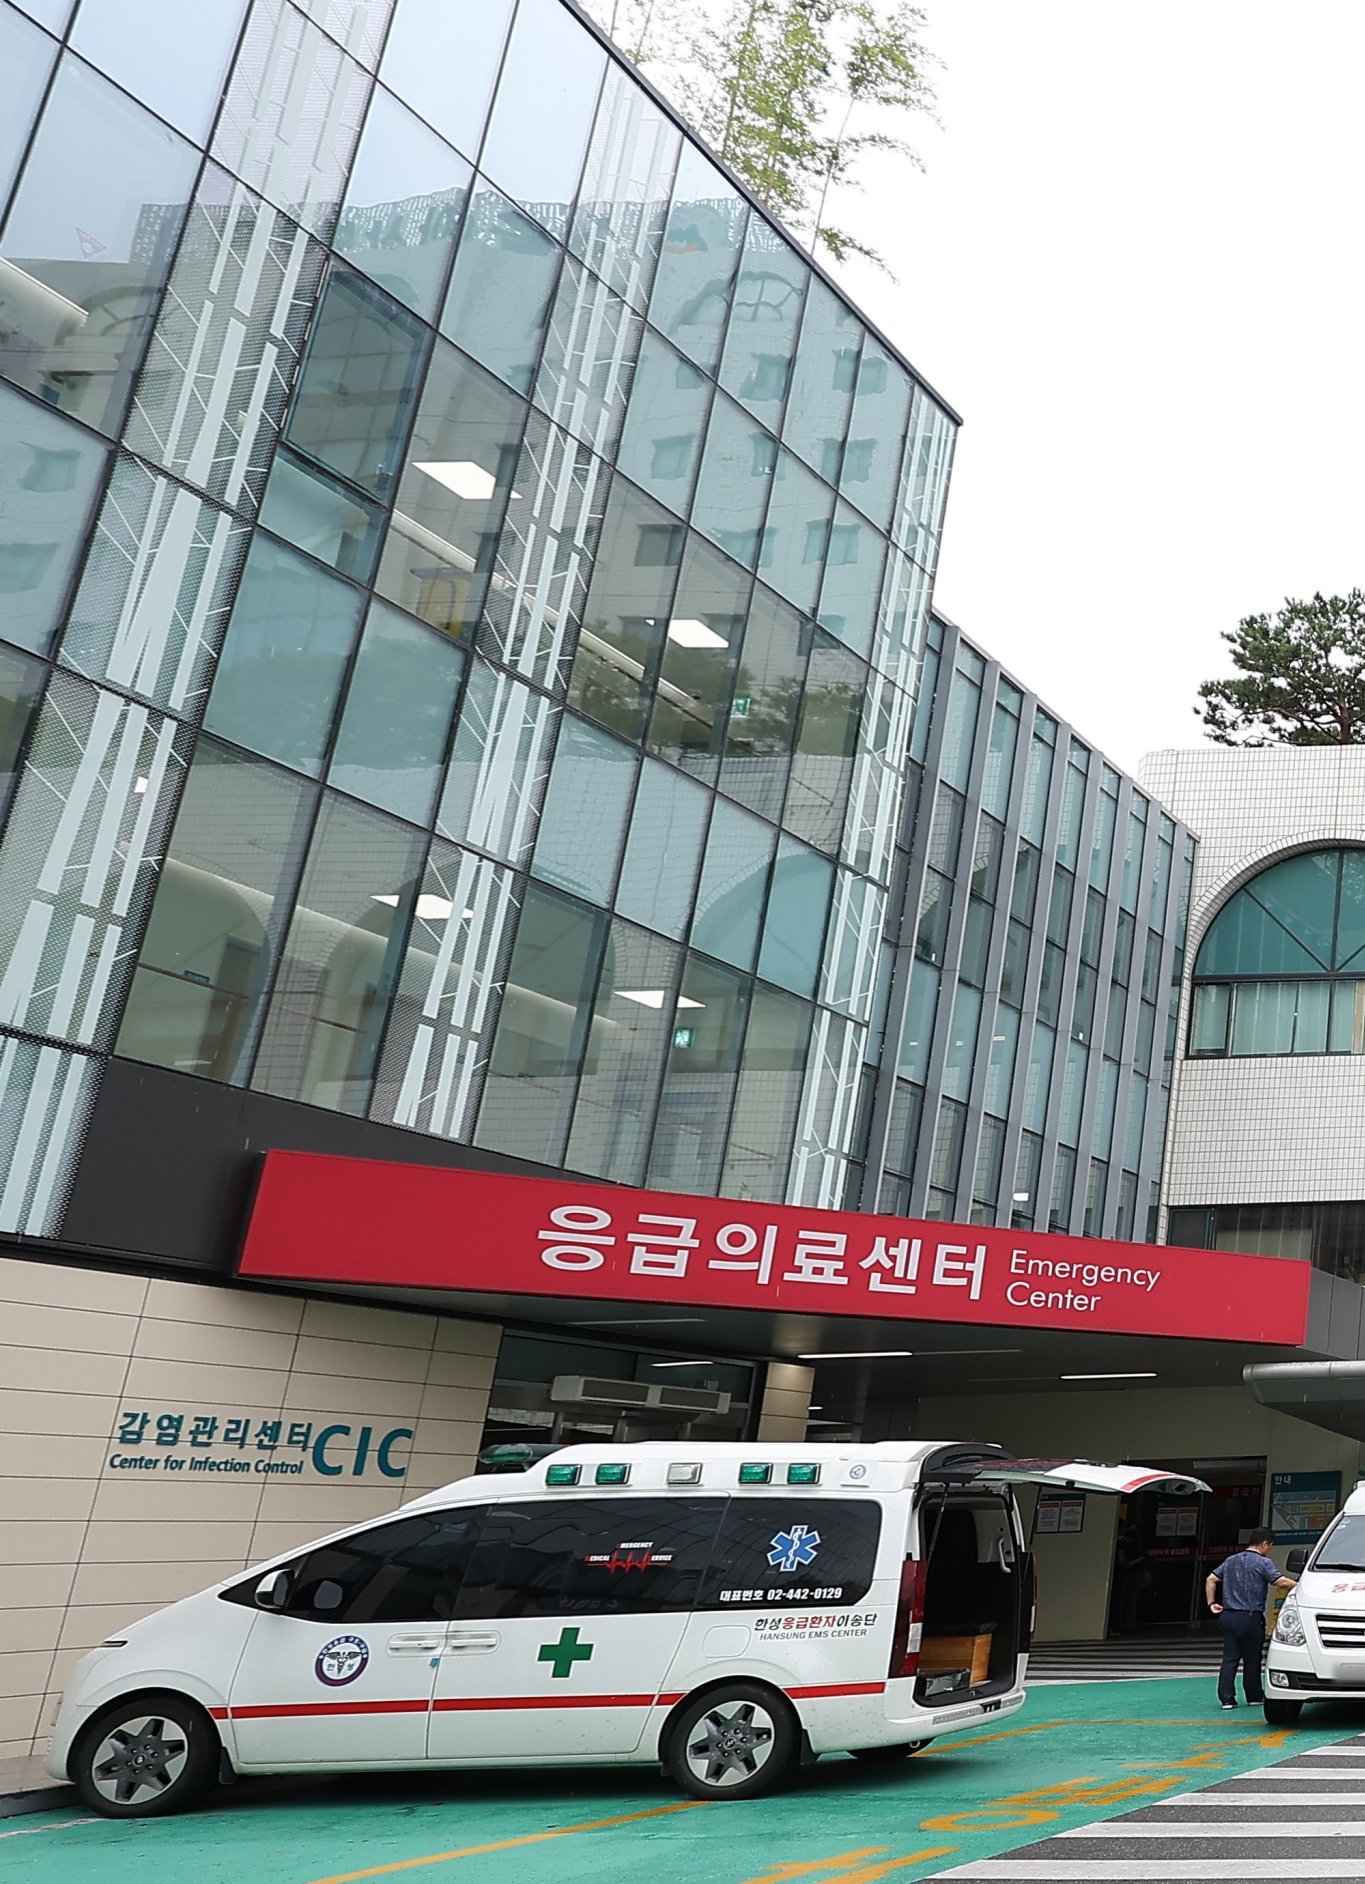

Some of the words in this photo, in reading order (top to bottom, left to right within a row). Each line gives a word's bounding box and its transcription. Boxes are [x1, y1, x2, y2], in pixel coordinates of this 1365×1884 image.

[536, 1204, 988, 1301] 응급의료센터
[1010, 1248, 1161, 1292] Emergency
[1006, 1282, 1102, 1312] Center
[118, 1411, 313, 1452] 감염관리센터
[109, 1453, 160, 1471] Center
[164, 1454, 186, 1472] for
[189, 1456, 251, 1473] Infection
[254, 1459, 304, 1475] Control
[311, 1424, 414, 1478] CIC
[1275, 1475, 1292, 1485] 안내
[719, 1589, 764, 1602] 대표번호
[766, 1587, 843, 1601] 02-442-0129
[754, 1613, 878, 1632] 한성응급환자이송단
[759, 1631, 806, 1641] HANSUNG
[808, 1630, 829, 1639] EMS
[831, 1628, 868, 1638] CENTER
